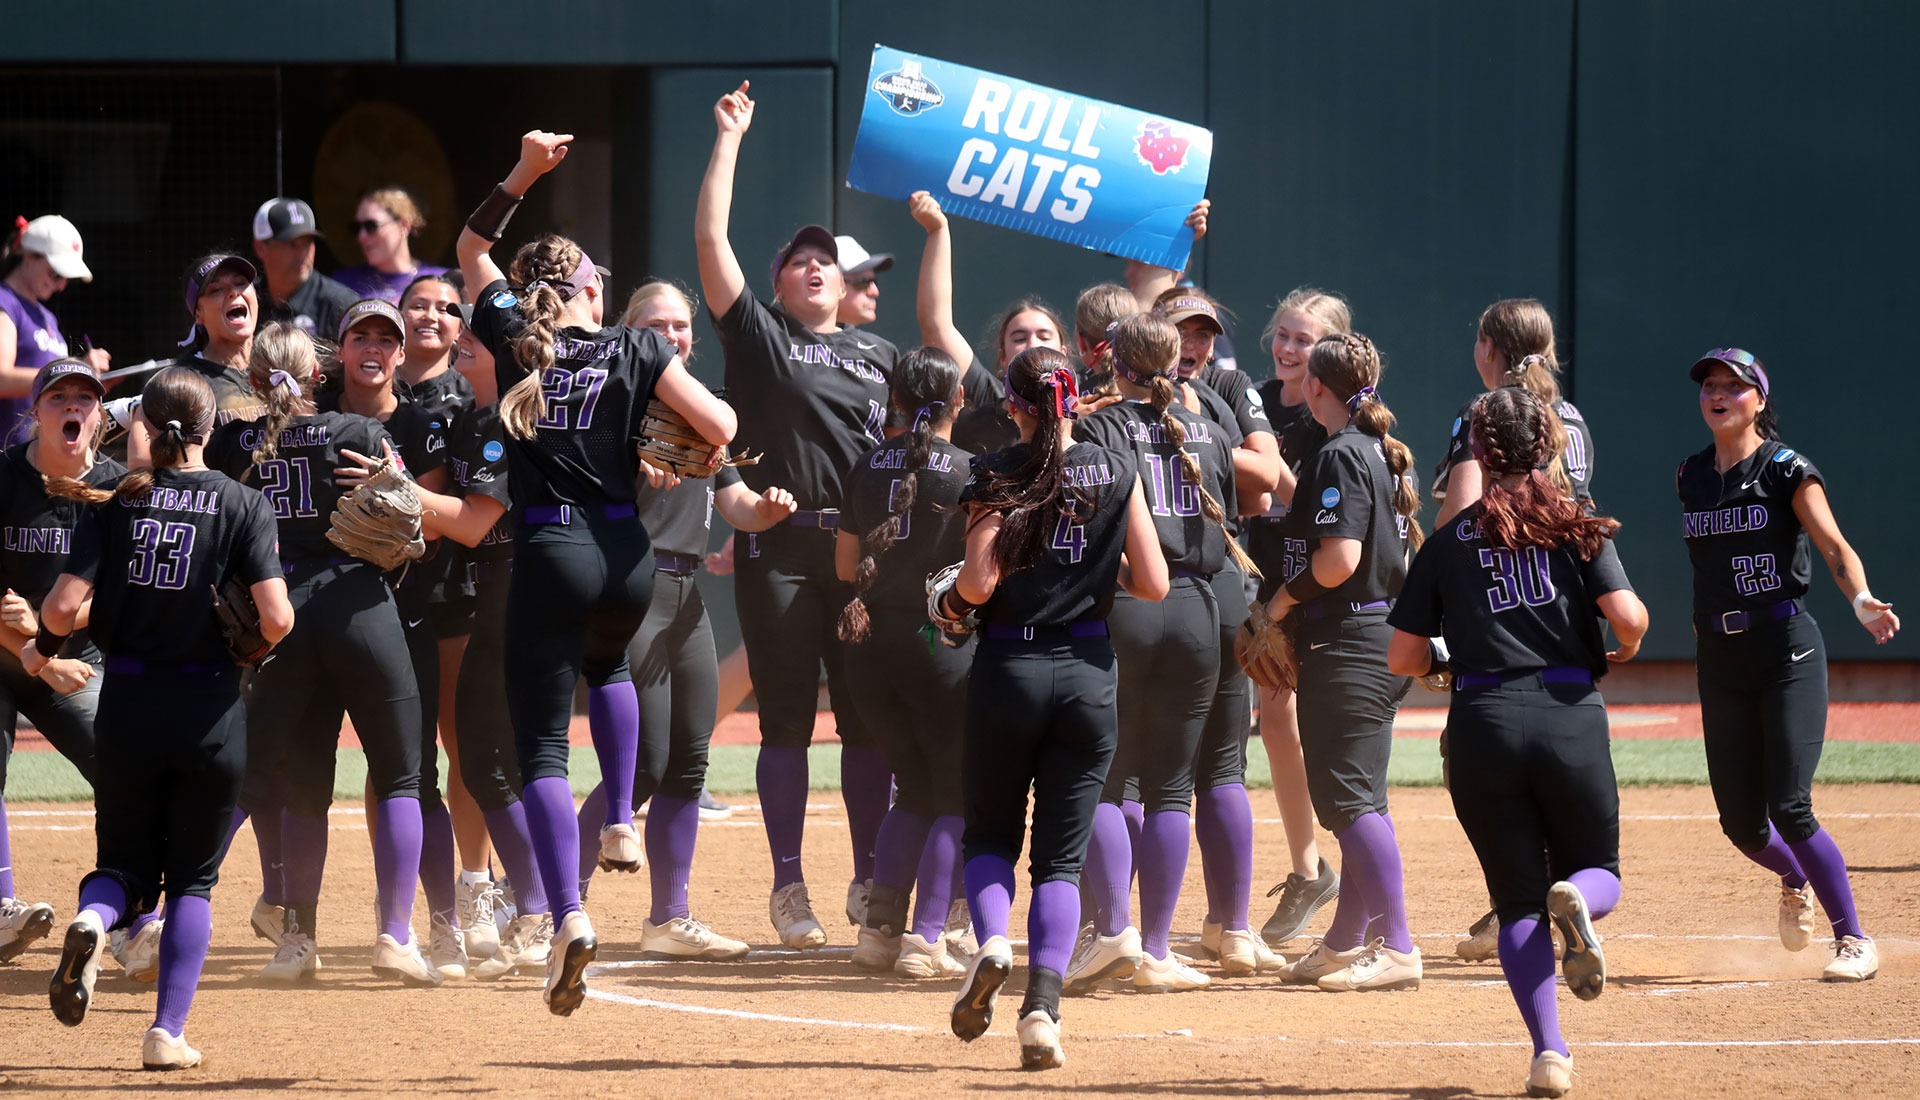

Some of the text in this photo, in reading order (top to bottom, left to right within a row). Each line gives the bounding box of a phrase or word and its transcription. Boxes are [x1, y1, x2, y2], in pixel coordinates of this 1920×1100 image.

[962, 77, 1101, 159] ROLL
[947, 137, 1101, 224] CATS
[286, 202, 304, 224] L
[536, 367, 609, 429] 27
[240, 426, 331, 451] CABALL
[259, 457, 319, 518] 21
[1145, 453, 1201, 517] 16
[4, 526, 74, 555] LINFI
[749, 534, 760, 558] L
[1052, 499, 1087, 564] 4
[1315, 509, 1338, 524] Cats
[1683, 504, 1768, 538] NFIELD
[128, 518, 196, 590] 33
[1479, 546, 1555, 613] 30
[1732, 554, 1781, 596] 23
